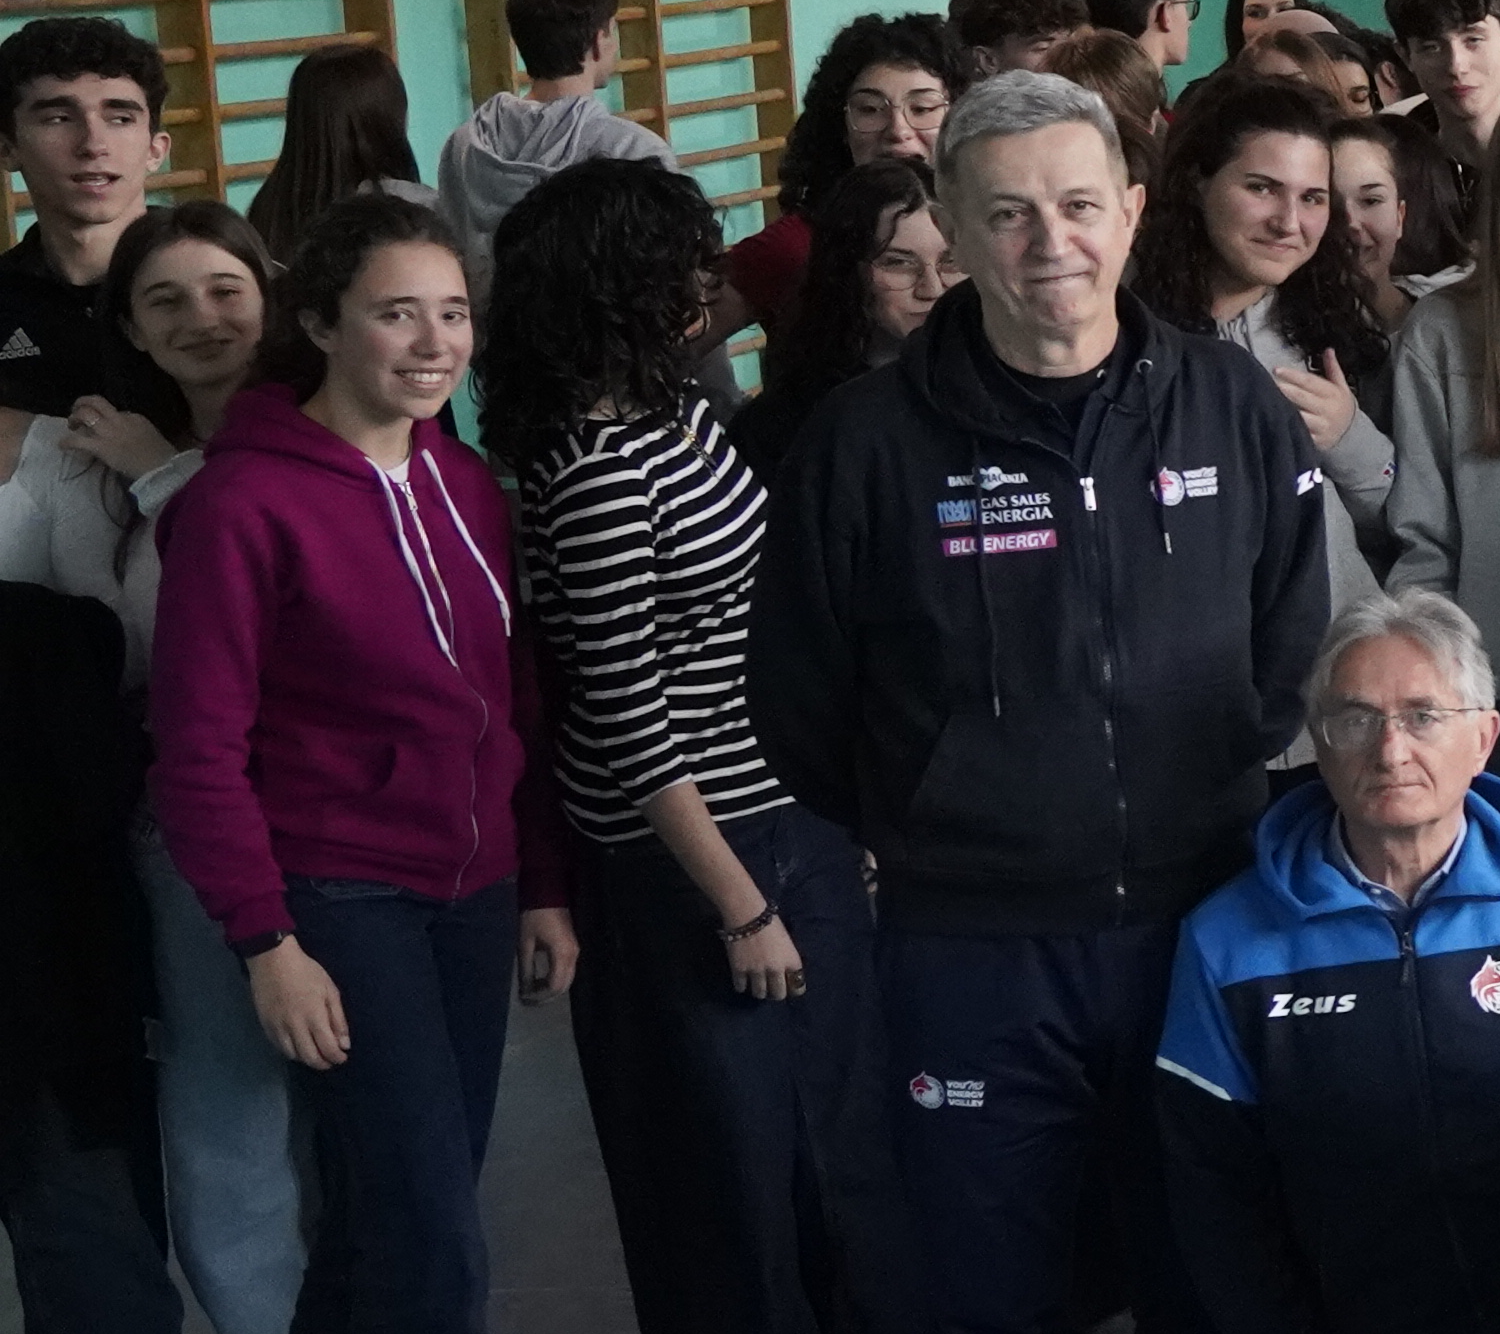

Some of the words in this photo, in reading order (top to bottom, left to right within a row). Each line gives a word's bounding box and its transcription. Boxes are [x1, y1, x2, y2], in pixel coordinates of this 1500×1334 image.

[0, 346, 41, 360] adidas
[980, 496, 1008, 510] GAS
[1009, 491, 1052, 508] SALES
[980, 505, 1054, 525] ENERGIA
[1267, 992, 1358, 1018] Zeus
